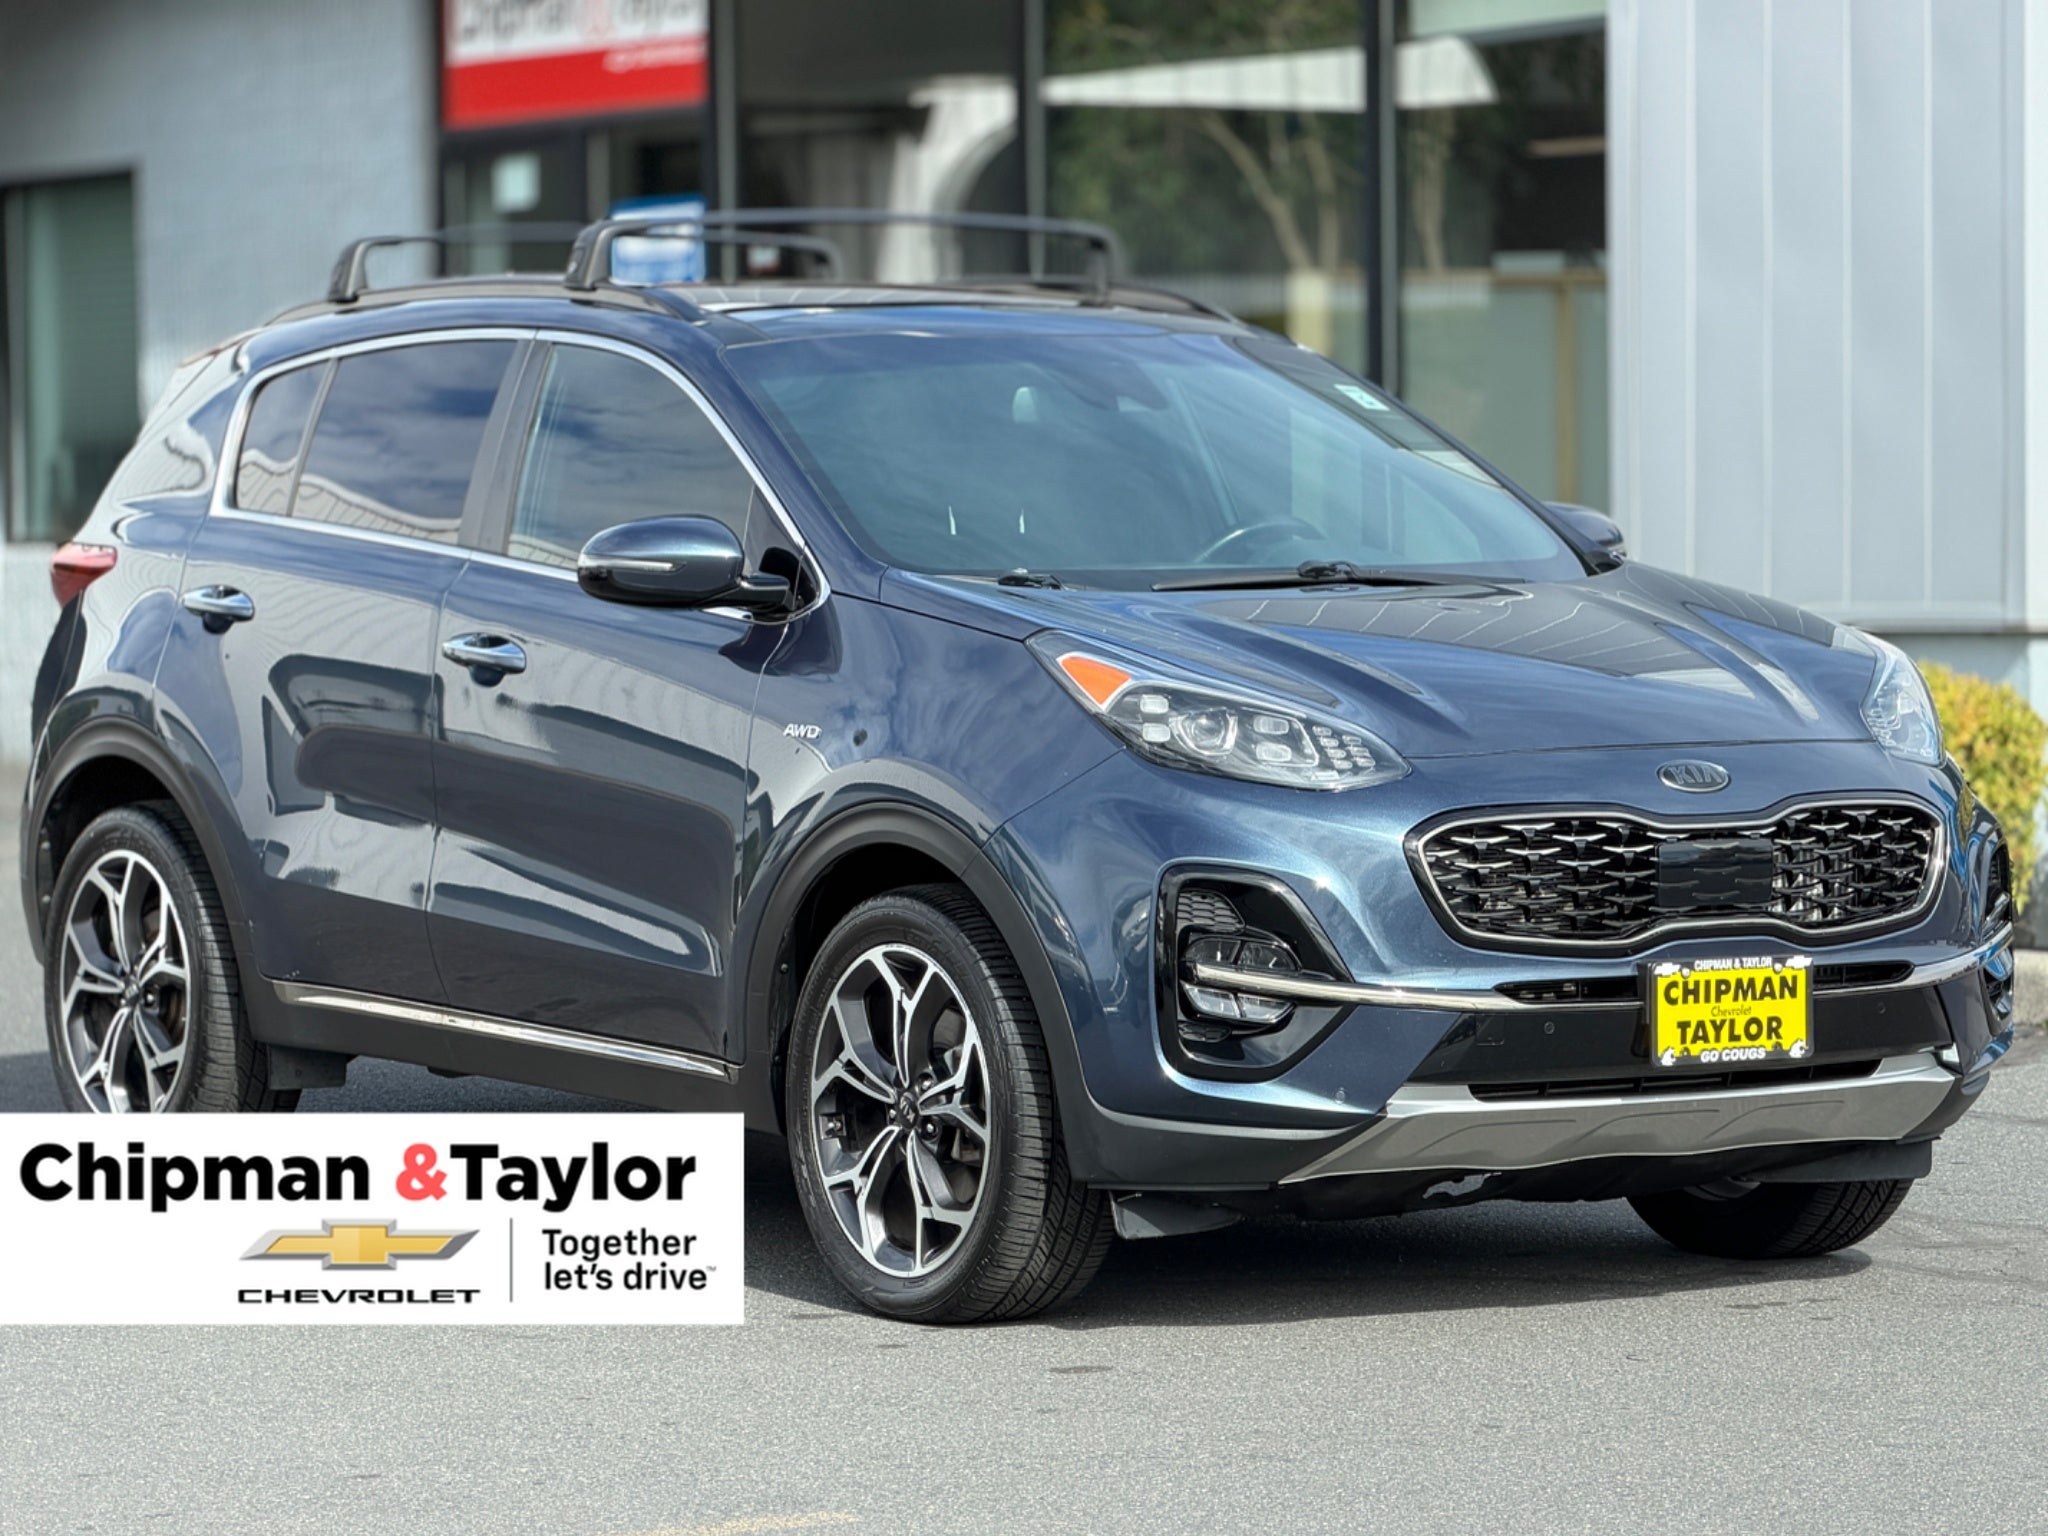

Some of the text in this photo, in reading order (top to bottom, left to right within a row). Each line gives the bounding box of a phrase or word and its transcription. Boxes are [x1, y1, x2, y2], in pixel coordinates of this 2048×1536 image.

[783, 723, 821, 739] AWD
[1669, 765, 1722, 784] KIA
[1694, 957, 1773, 971] CHIPMAN & TAYLOR
[1664, 975, 1798, 1006] CHIPMAN
[1710, 1005, 1752, 1018] Chevrolet
[1677, 1016, 1783, 1045] TAYLOR
[1700, 1046, 1767, 1063] GO COUGS
